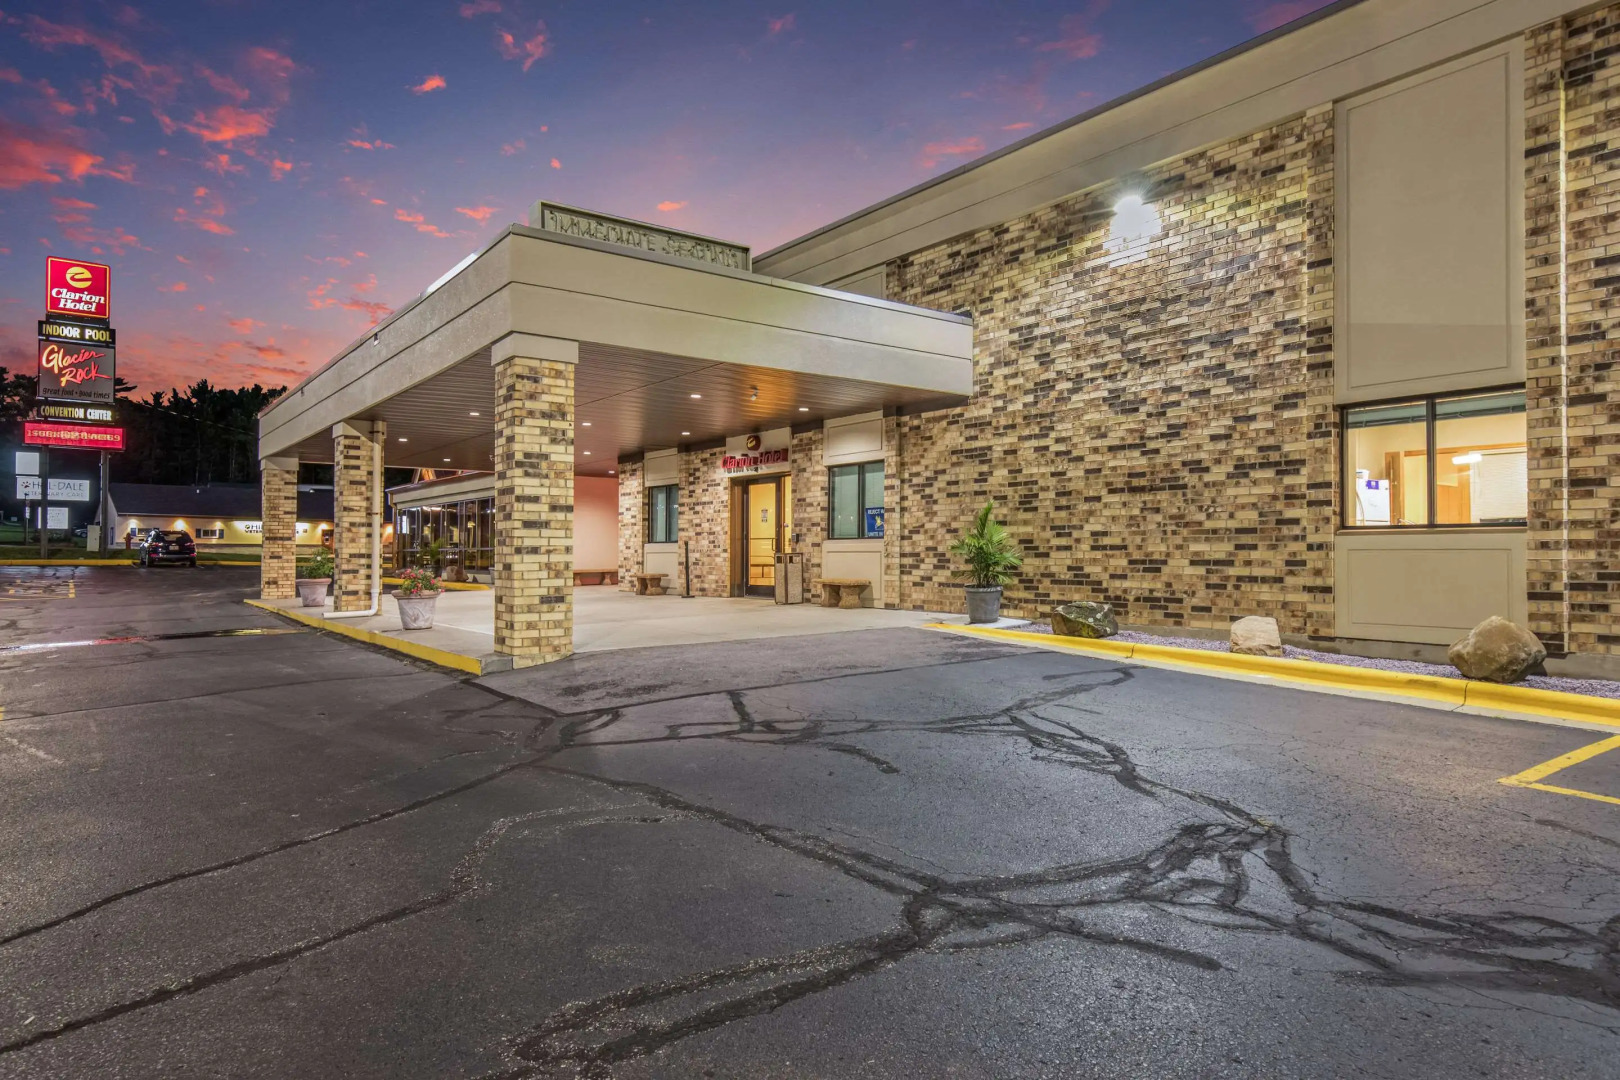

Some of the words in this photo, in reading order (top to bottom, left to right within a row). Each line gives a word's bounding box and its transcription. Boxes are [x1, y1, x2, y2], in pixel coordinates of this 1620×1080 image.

[51, 287, 105, 304] Clarion
[58, 298, 96, 312] Hotel
[42, 323, 81, 339] INDOOR
[85, 328, 112, 342] POOL
[42, 344, 105, 374] Glacier
[42, 387, 60, 395] great
[61, 388, 74, 397] food
[78, 390, 92, 398] good
[93, 391, 111, 399] times
[40, 405, 85, 419] CONVENTION
[86, 408, 112, 421] CENTER
[721, 455, 759, 469] Clarion
[757, 447, 789, 465] Hotel
[32, 480, 84, 491] HL-DALE
